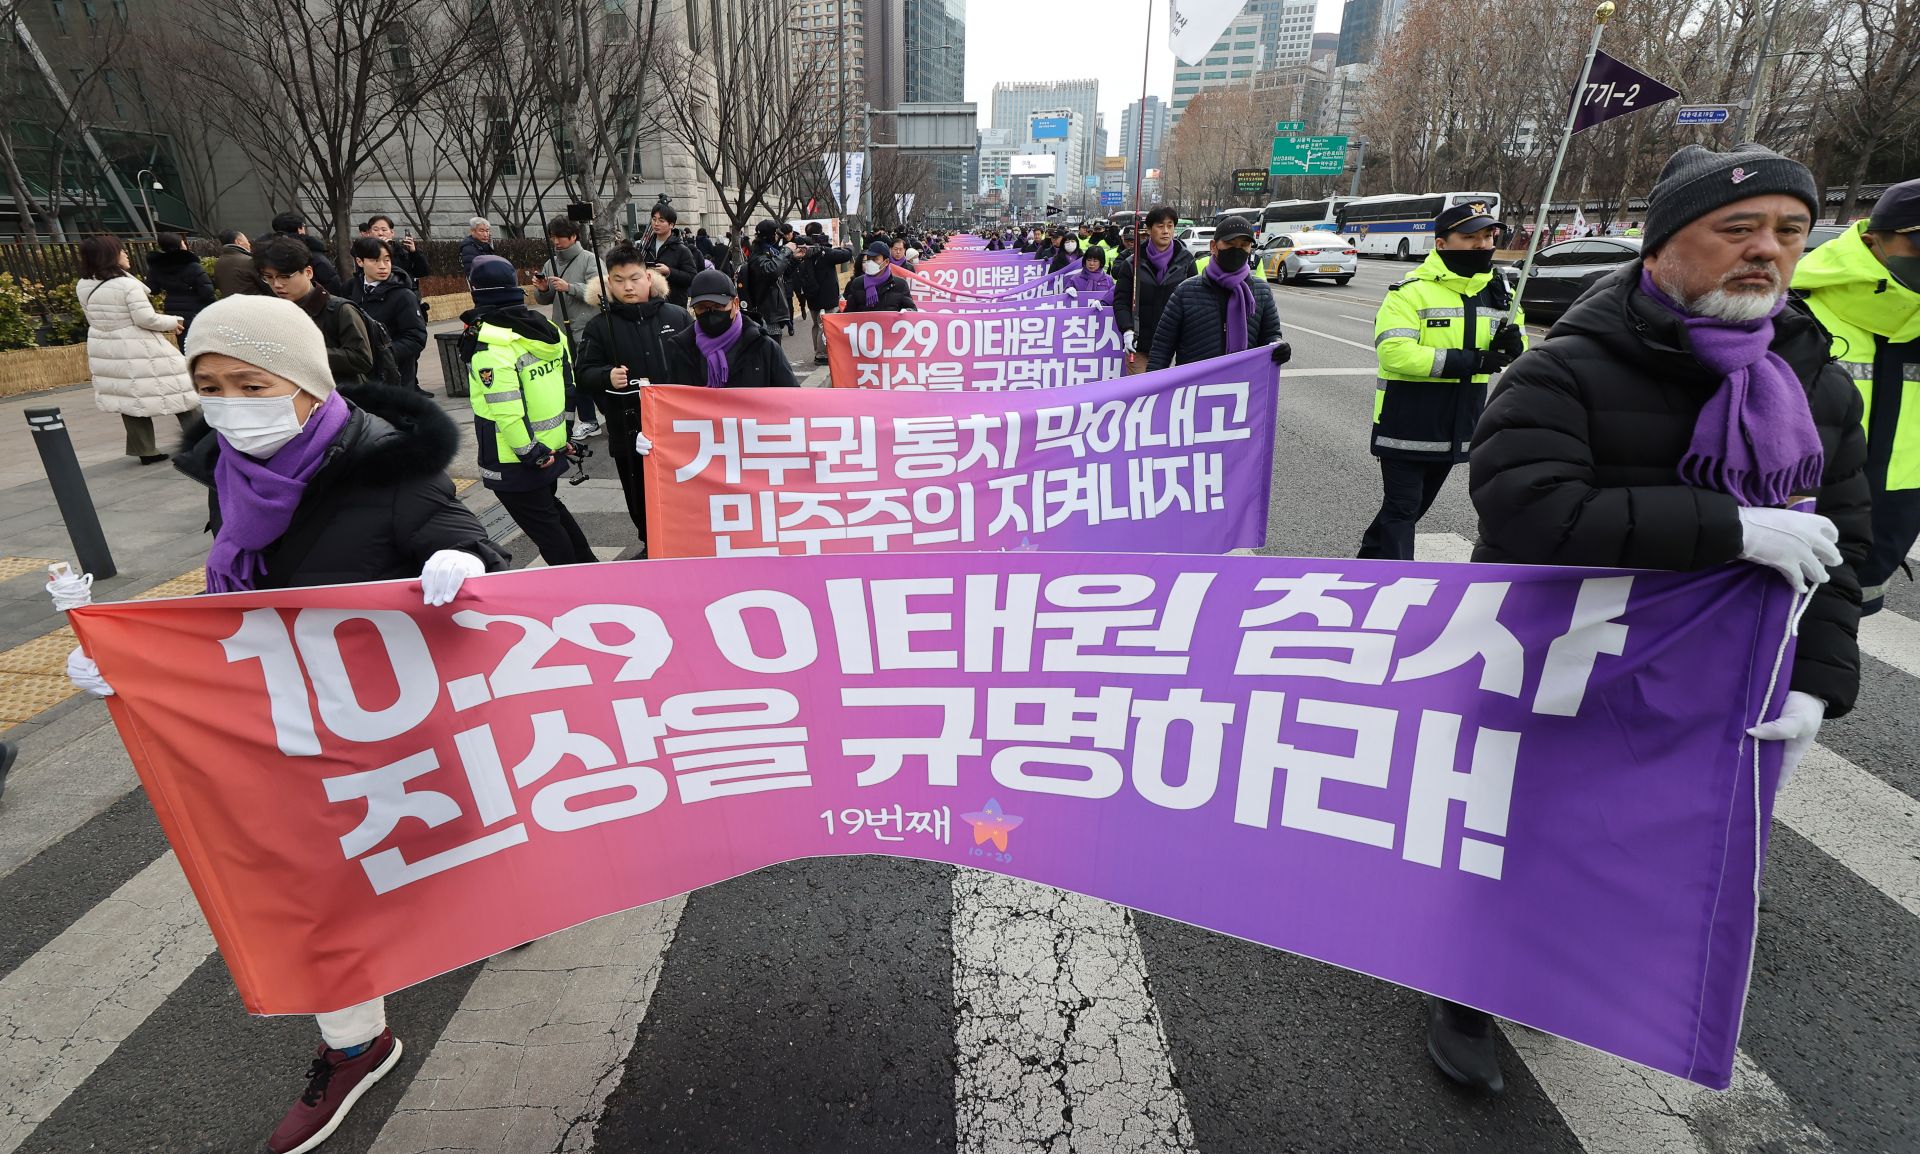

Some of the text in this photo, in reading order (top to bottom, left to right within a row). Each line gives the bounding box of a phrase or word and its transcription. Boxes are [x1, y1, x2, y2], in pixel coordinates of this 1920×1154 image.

[961, 265, 1020, 289] 이태원
[843, 318, 939, 359] 10.29
[946, 316, 1057, 357] 이태원
[672, 381, 1252, 486] 거부권 통치 막아내고
[708, 451, 1225, 557] 민주주의 지켜내자!
[218, 571, 1636, 757] 10.29 이태원 참사
[320, 685, 1523, 897] 진상을 규명하라!
[819, 803, 951, 845] 19번째
